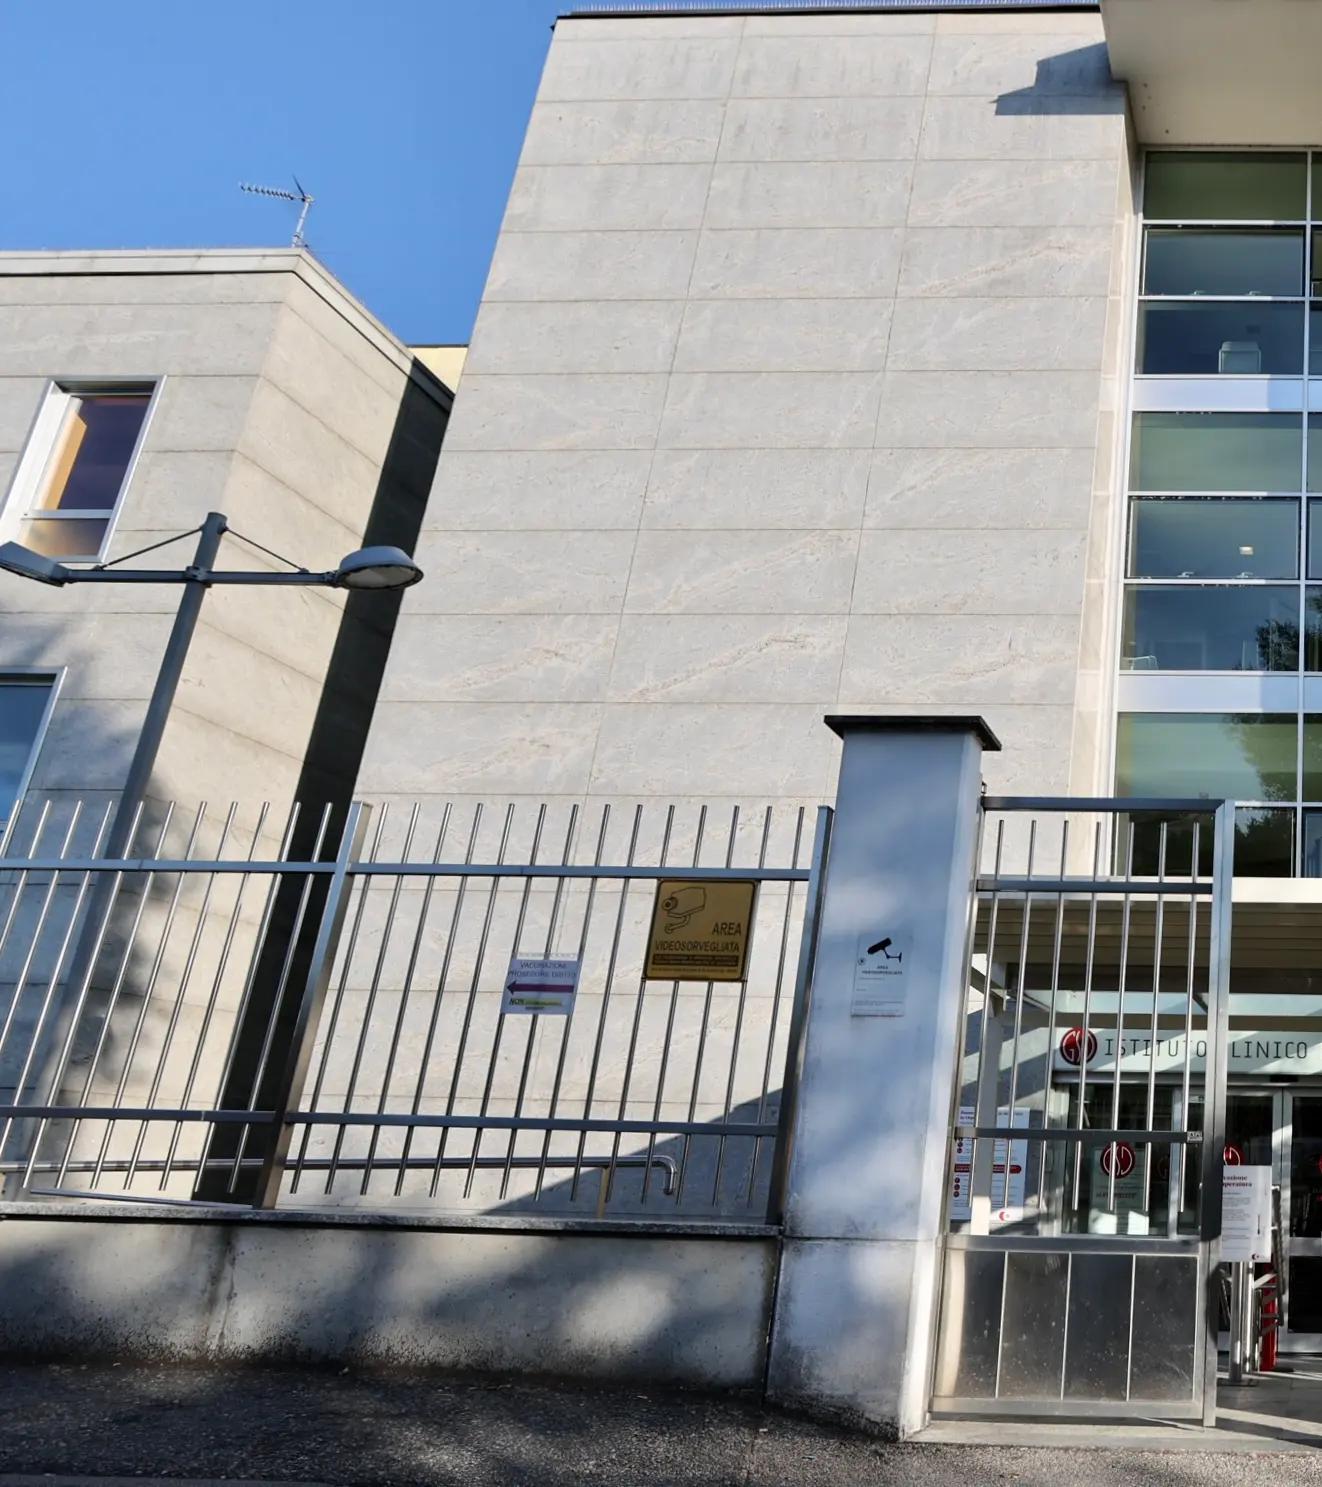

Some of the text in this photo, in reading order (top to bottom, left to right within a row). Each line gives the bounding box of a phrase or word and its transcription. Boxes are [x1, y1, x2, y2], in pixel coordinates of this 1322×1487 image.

[712, 922, 742, 936] AREA
[655, 940, 740, 953] VIDEOSORVEGLIATA
[1105, 1039, 1208, 1058] ISTITUO
[1231, 1041, 1308, 1059] LINICO
